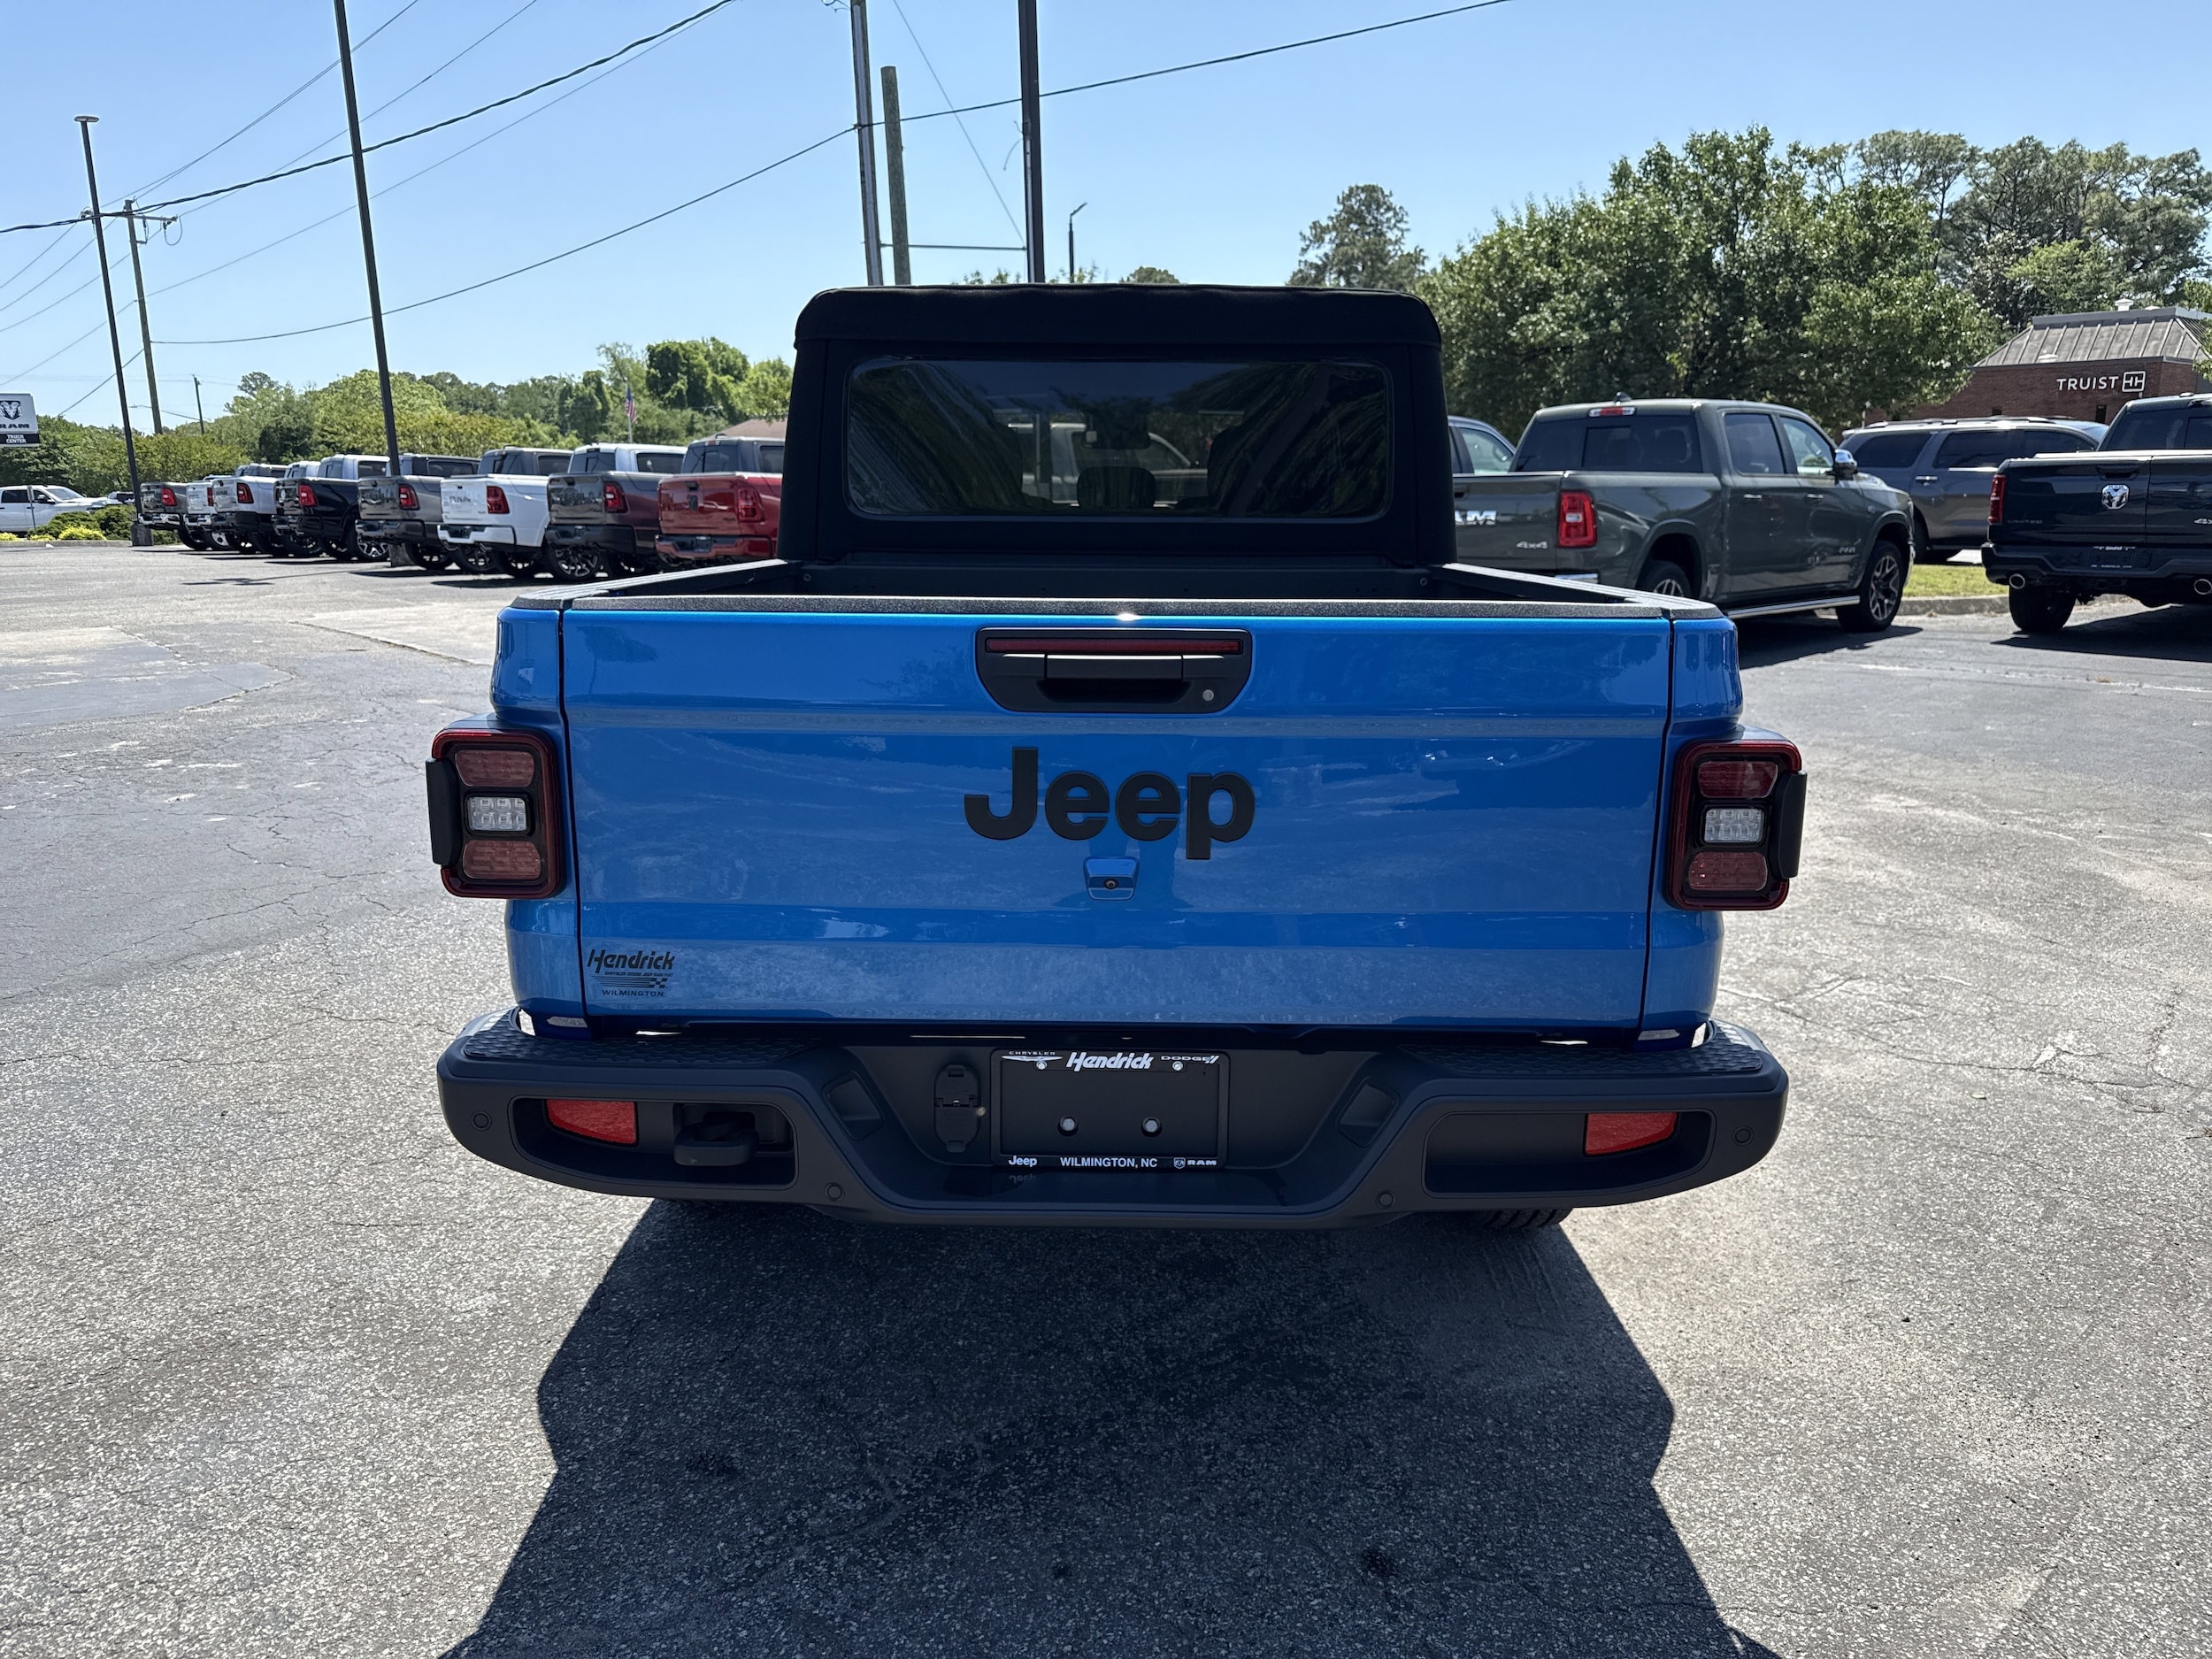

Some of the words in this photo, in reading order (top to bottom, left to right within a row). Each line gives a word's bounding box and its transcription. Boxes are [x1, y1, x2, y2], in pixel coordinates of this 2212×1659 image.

[2056, 376, 2119, 390] TRUIST
[1455, 511, 1496, 526] AM
[964, 747, 1255, 860] Jeep
[587, 949, 675, 973] Hendrick
[1066, 1052, 1154, 1071] Hendrick
[1009, 1156, 1038, 1167] Jeep
[1060, 1157, 1139, 1169] WILMINGTON,
[1141, 1158, 1158, 1167] NC
